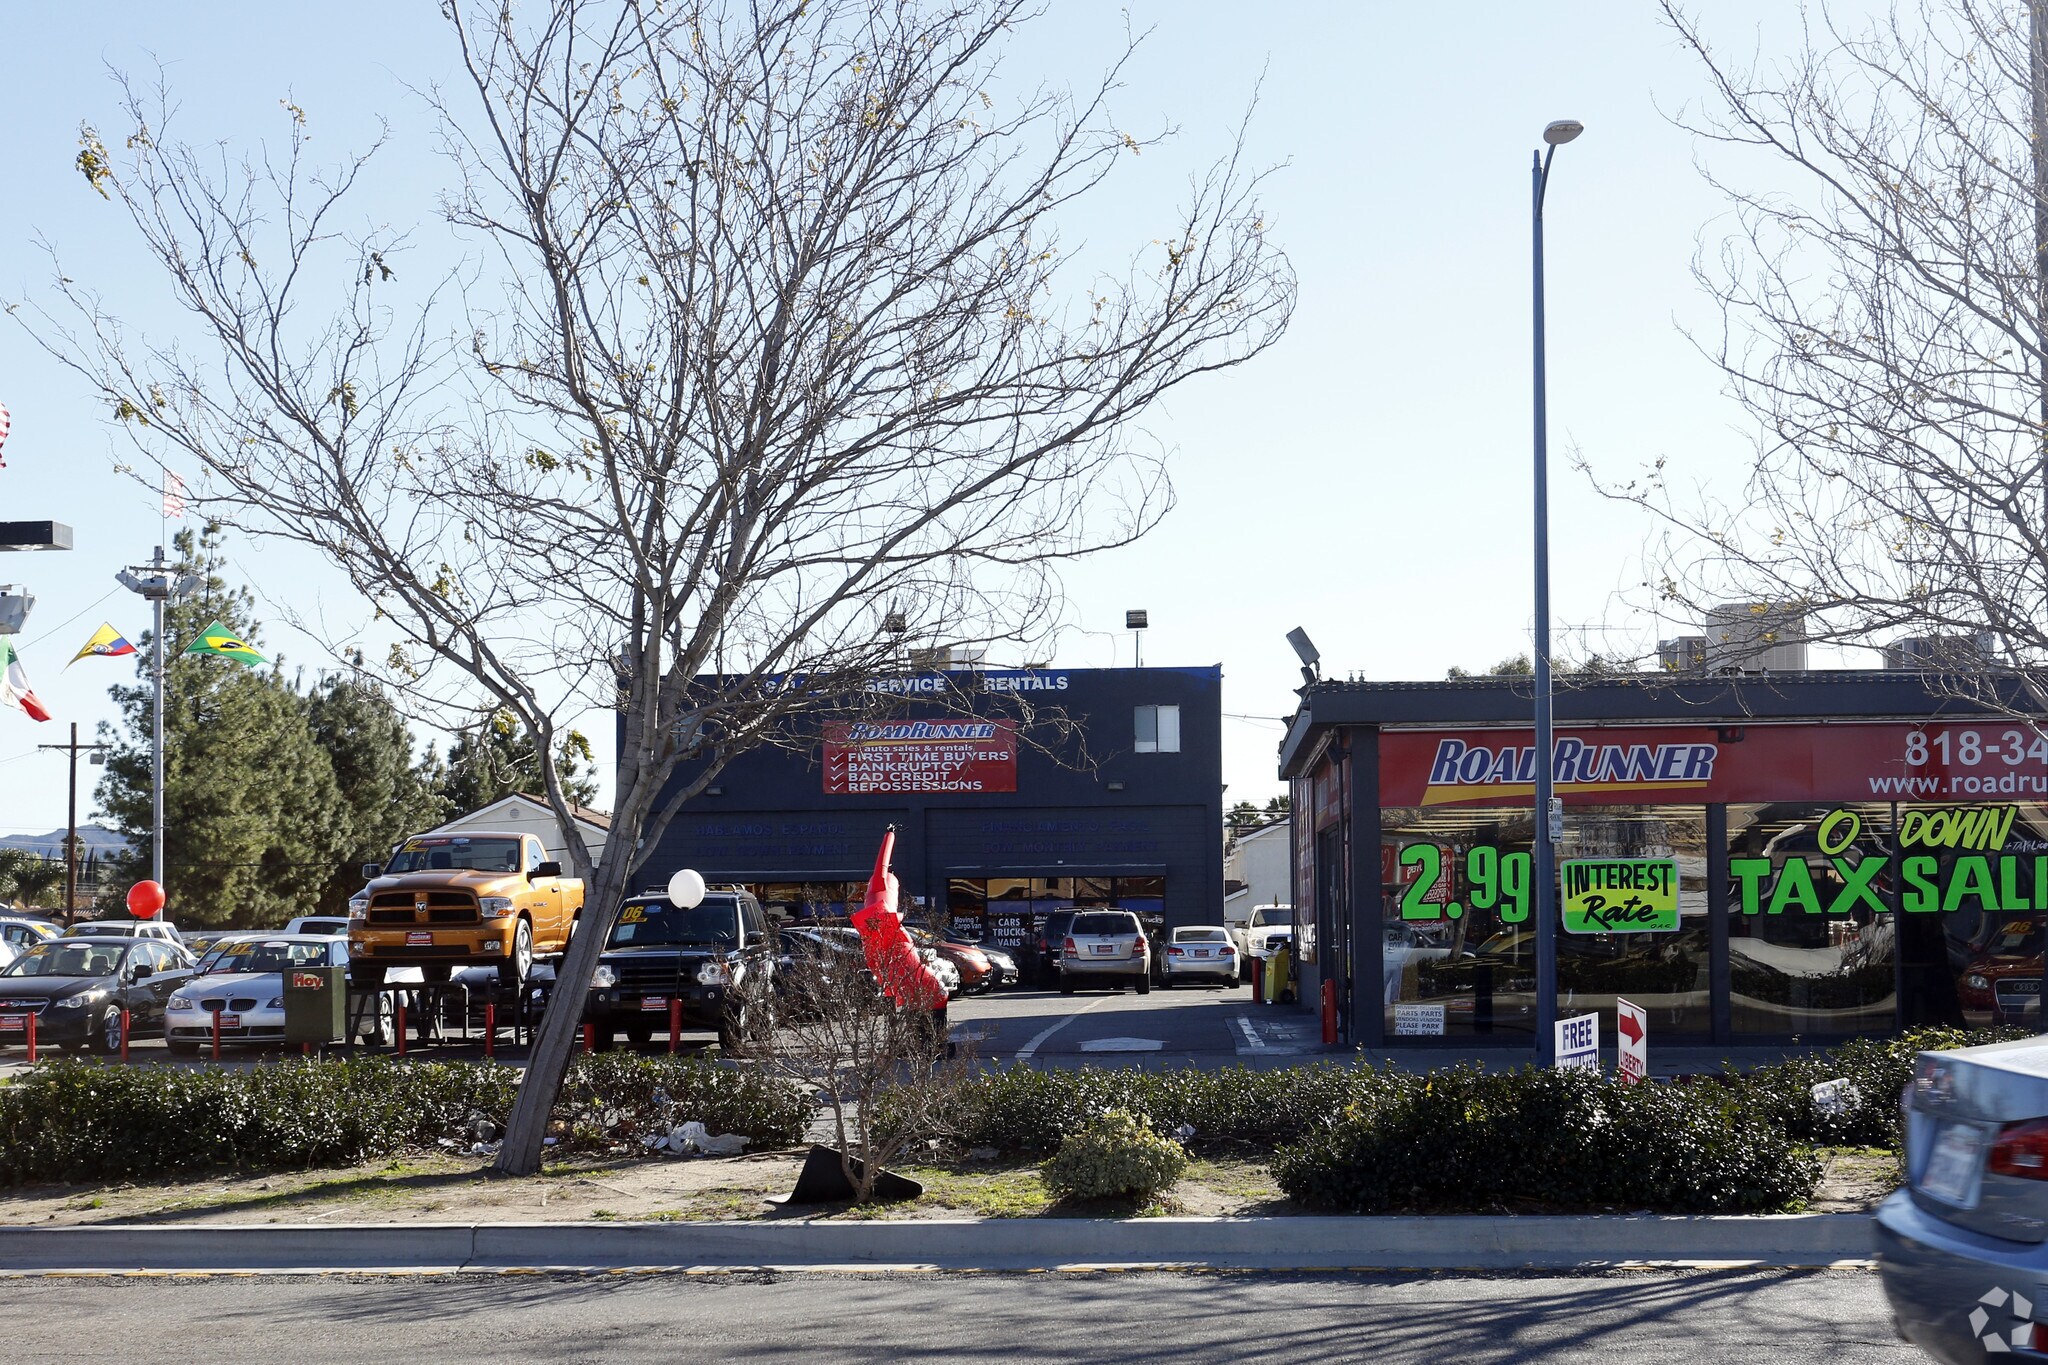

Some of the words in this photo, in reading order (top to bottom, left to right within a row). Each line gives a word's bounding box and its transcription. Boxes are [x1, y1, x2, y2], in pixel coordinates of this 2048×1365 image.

[866, 677, 945, 692] SERVICE
[983, 676, 1069, 691] RENTALS
[849, 722, 995, 740] ROADRUNNER
[893, 743, 920, 752] sales
[924, 744, 931, 752] &
[934, 743, 973, 752] rentals
[848, 752, 893, 762] FIRST
[899, 752, 941, 761] TIME
[943, 751, 1009, 761] BUYERS
[1427, 736, 1718, 786] ROADRUNNER
[848, 762, 964, 772] BANKRUPTCY
[848, 772, 886, 782] BAD
[890, 771, 950, 781] CREDIT
[848, 781, 983, 792] REPOSSESSIONS
[1899, 804, 2020, 852] DOWN
[1399, 842, 1532, 924] 2.99
[1566, 863, 1674, 900] INTEREST
[1728, 855, 1892, 915] TAX
[622, 905, 645, 919] 06
[1582, 895, 1659, 931] Rate
[953, 916, 975, 925] Moving
[953, 922, 971, 931] Cargo
[997, 917, 1021, 927] CARS
[992, 928, 1026, 937] TRUCKS
[997, 938, 1021, 947] VANS
[293, 972, 324, 990] Hoy
[1562, 1018, 1593, 1051] FREE
[1620, 1049, 1644, 1075] LIBERTY
